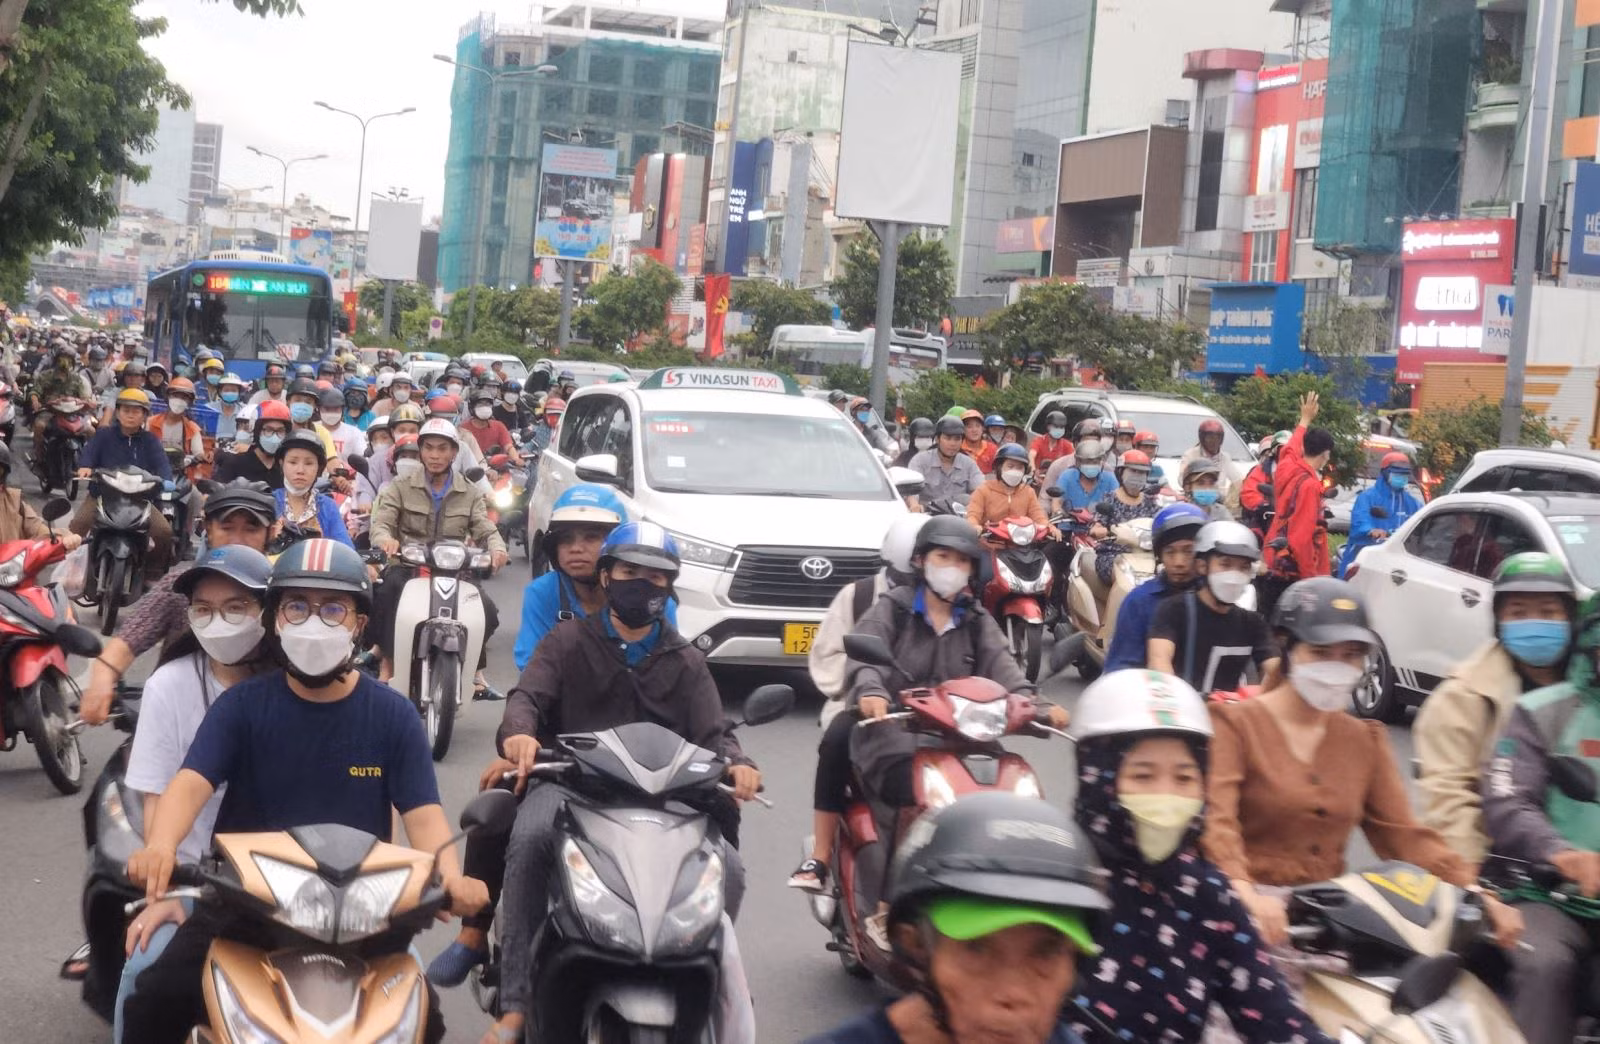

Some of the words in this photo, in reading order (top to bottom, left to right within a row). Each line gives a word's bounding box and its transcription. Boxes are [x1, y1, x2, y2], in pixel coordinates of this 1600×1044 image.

[730, 214, 742, 223] EM
[690, 373, 749, 386] VINASUN
[752, 376, 777, 388] TAXI
[793, 641, 812, 653] 12
